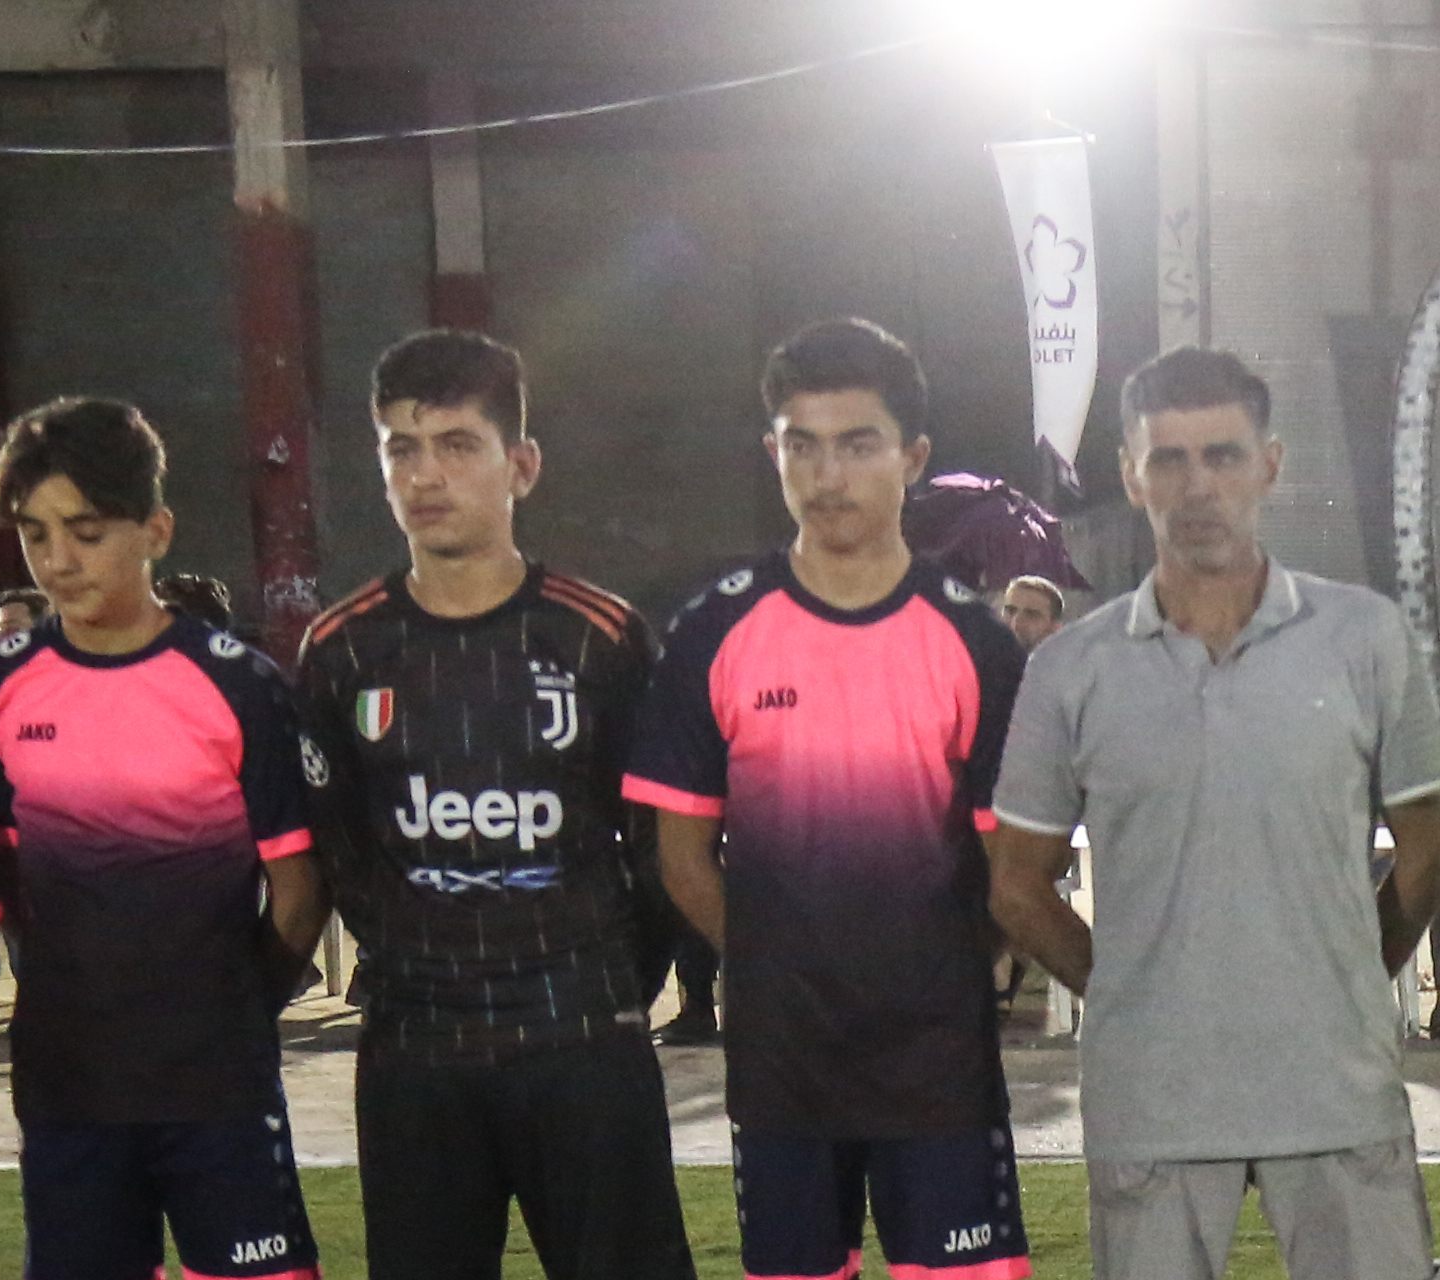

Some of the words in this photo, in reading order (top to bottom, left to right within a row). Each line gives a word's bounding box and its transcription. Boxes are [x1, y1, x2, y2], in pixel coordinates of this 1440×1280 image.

[754, 687, 798, 710] JAKO
[396, 775, 563, 851] Jeep
[231, 1234, 287, 1264] JAKO
[944, 1223, 991, 1253] JAKO
